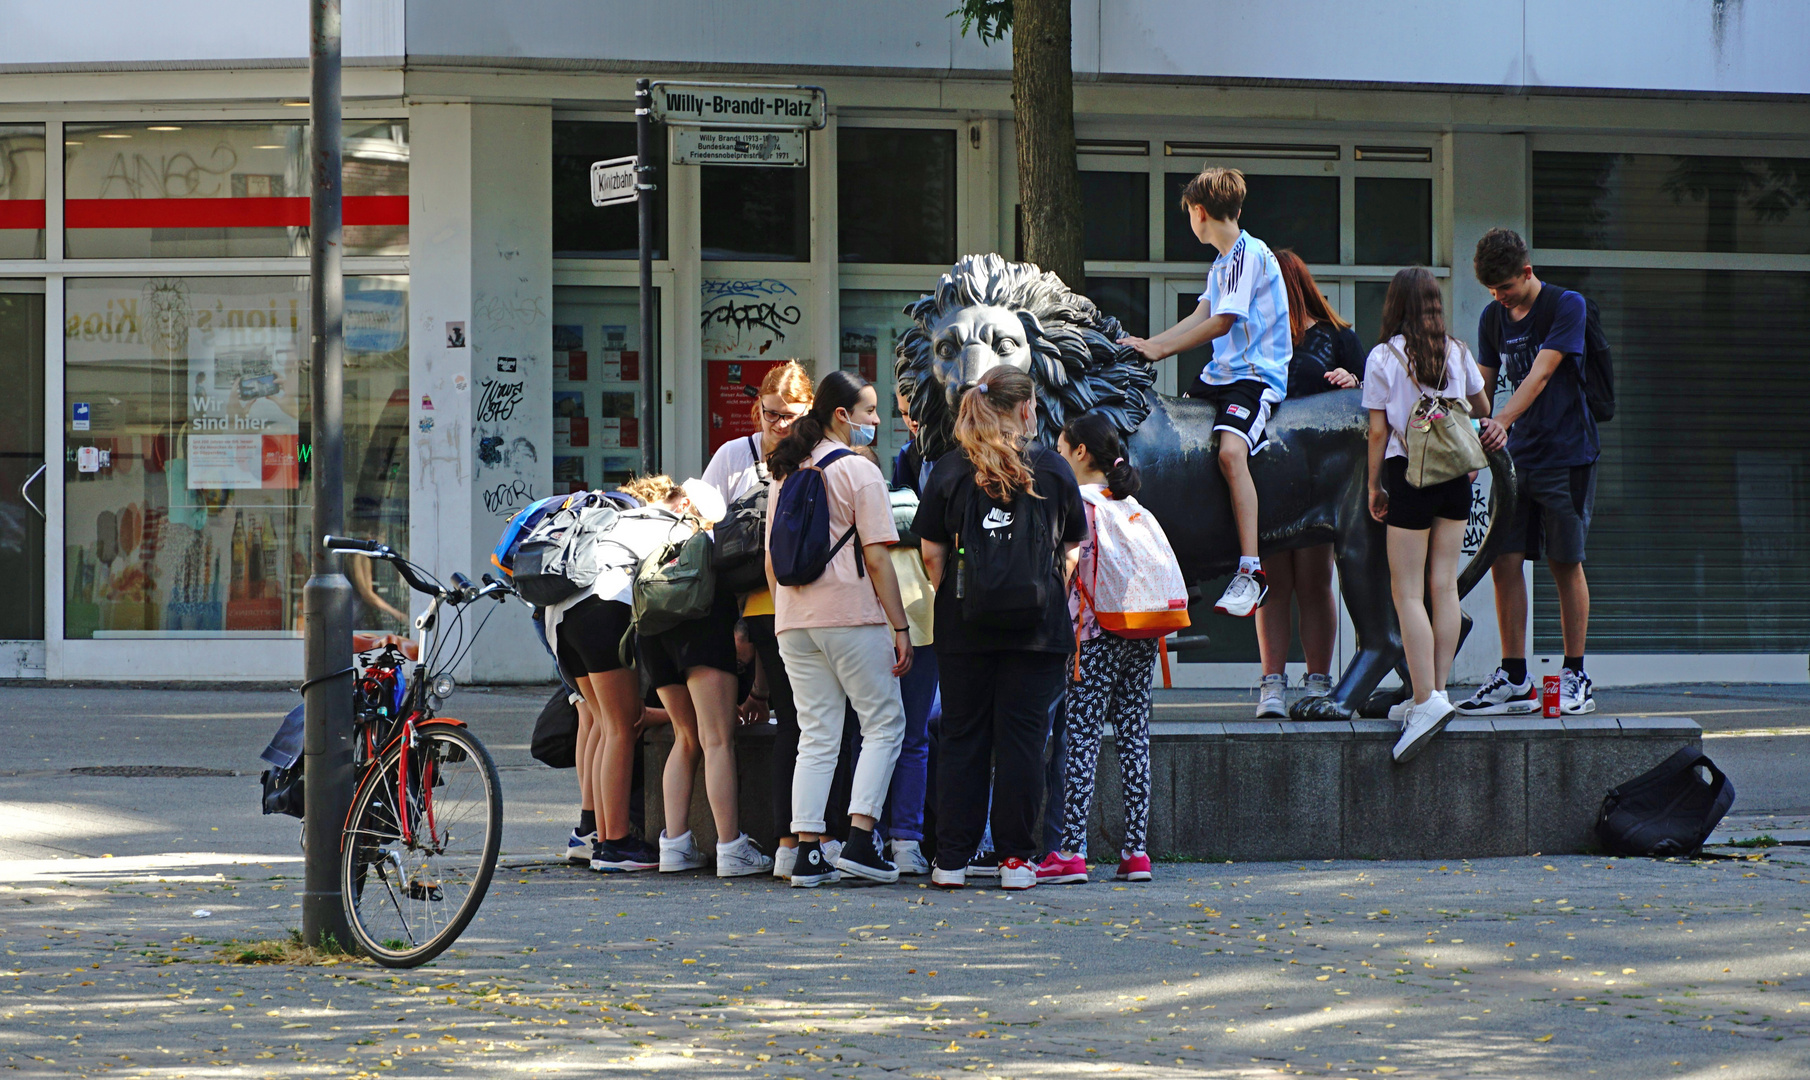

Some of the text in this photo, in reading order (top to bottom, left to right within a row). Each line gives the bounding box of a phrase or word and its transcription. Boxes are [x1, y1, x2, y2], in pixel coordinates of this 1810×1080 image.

[666, 93, 812, 117] Willy-Brandt-Platz
[699, 134, 716, 143] Willy
[193, 396, 223, 412] Wir
[193, 414, 271, 430] sind hier.
[989, 507, 1011, 523] NIKE
